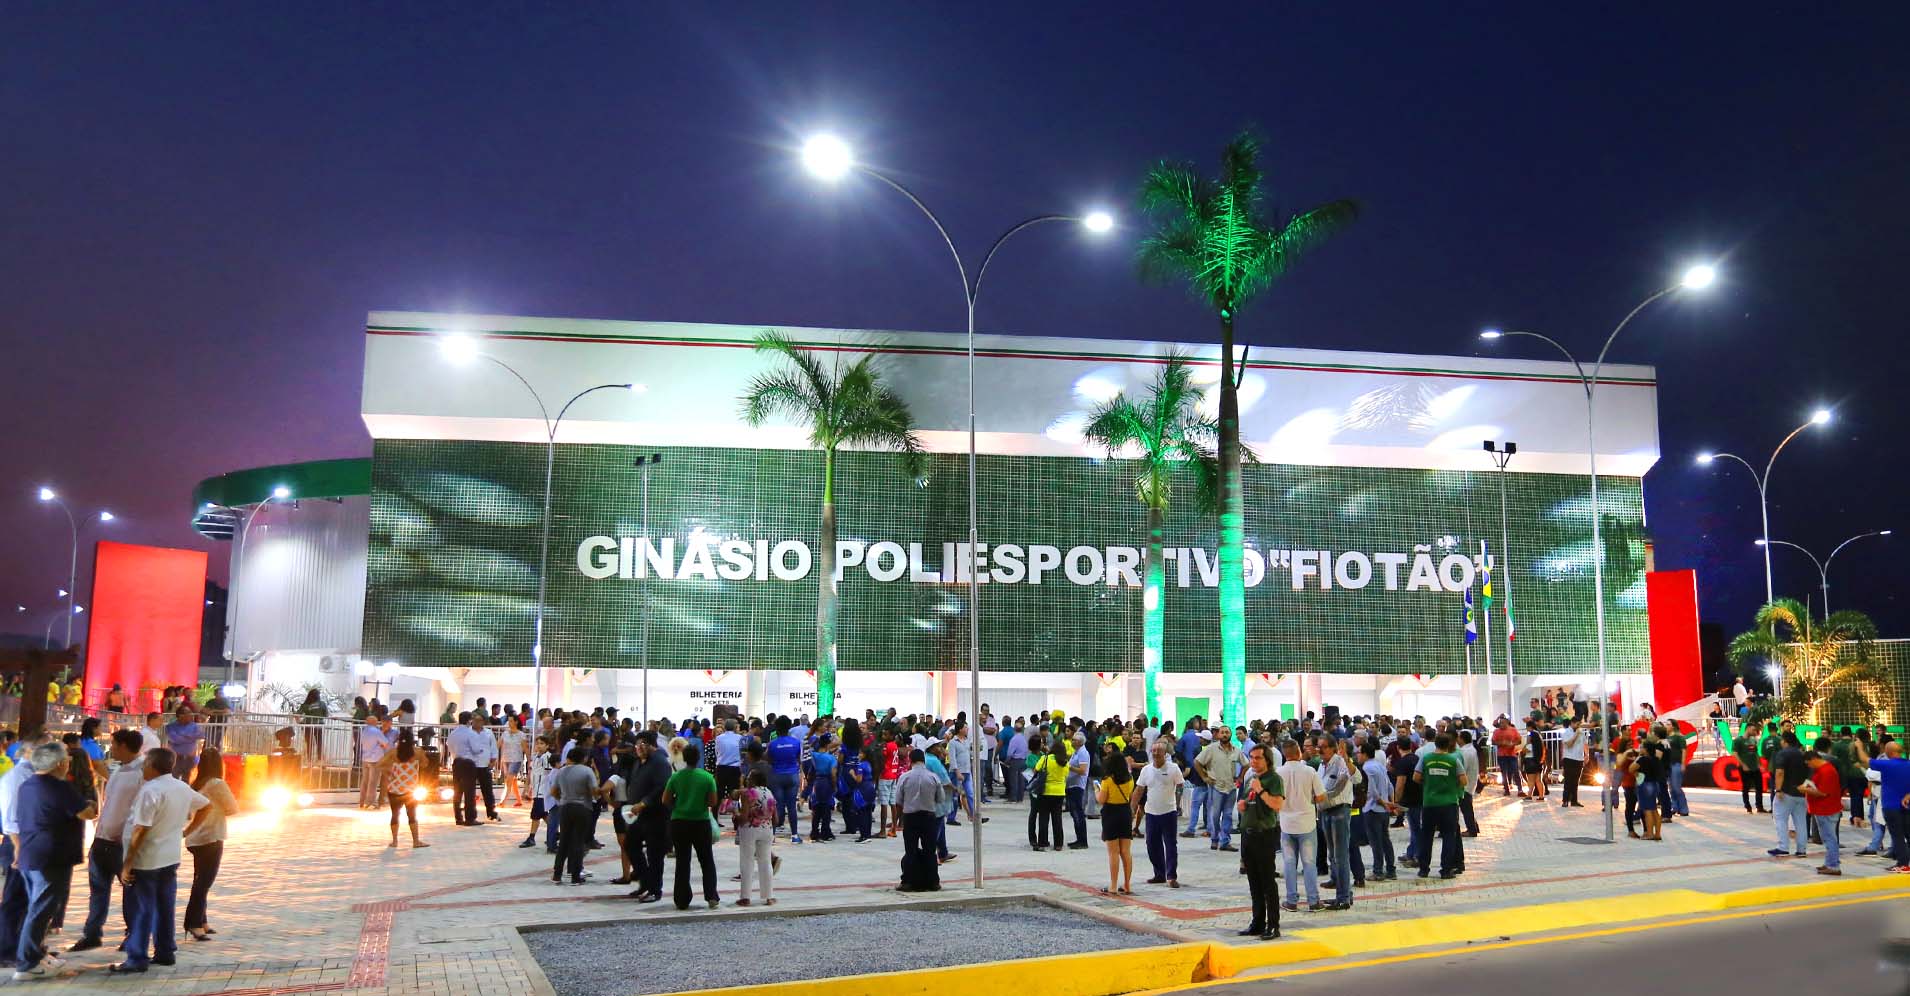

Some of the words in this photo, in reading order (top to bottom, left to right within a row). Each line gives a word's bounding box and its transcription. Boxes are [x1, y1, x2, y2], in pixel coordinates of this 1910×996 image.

[577, 527, 813, 581] GINÁSIO
[690, 691, 743, 699] BILHETERIA
[789, 692, 842, 700] BILHEIA
